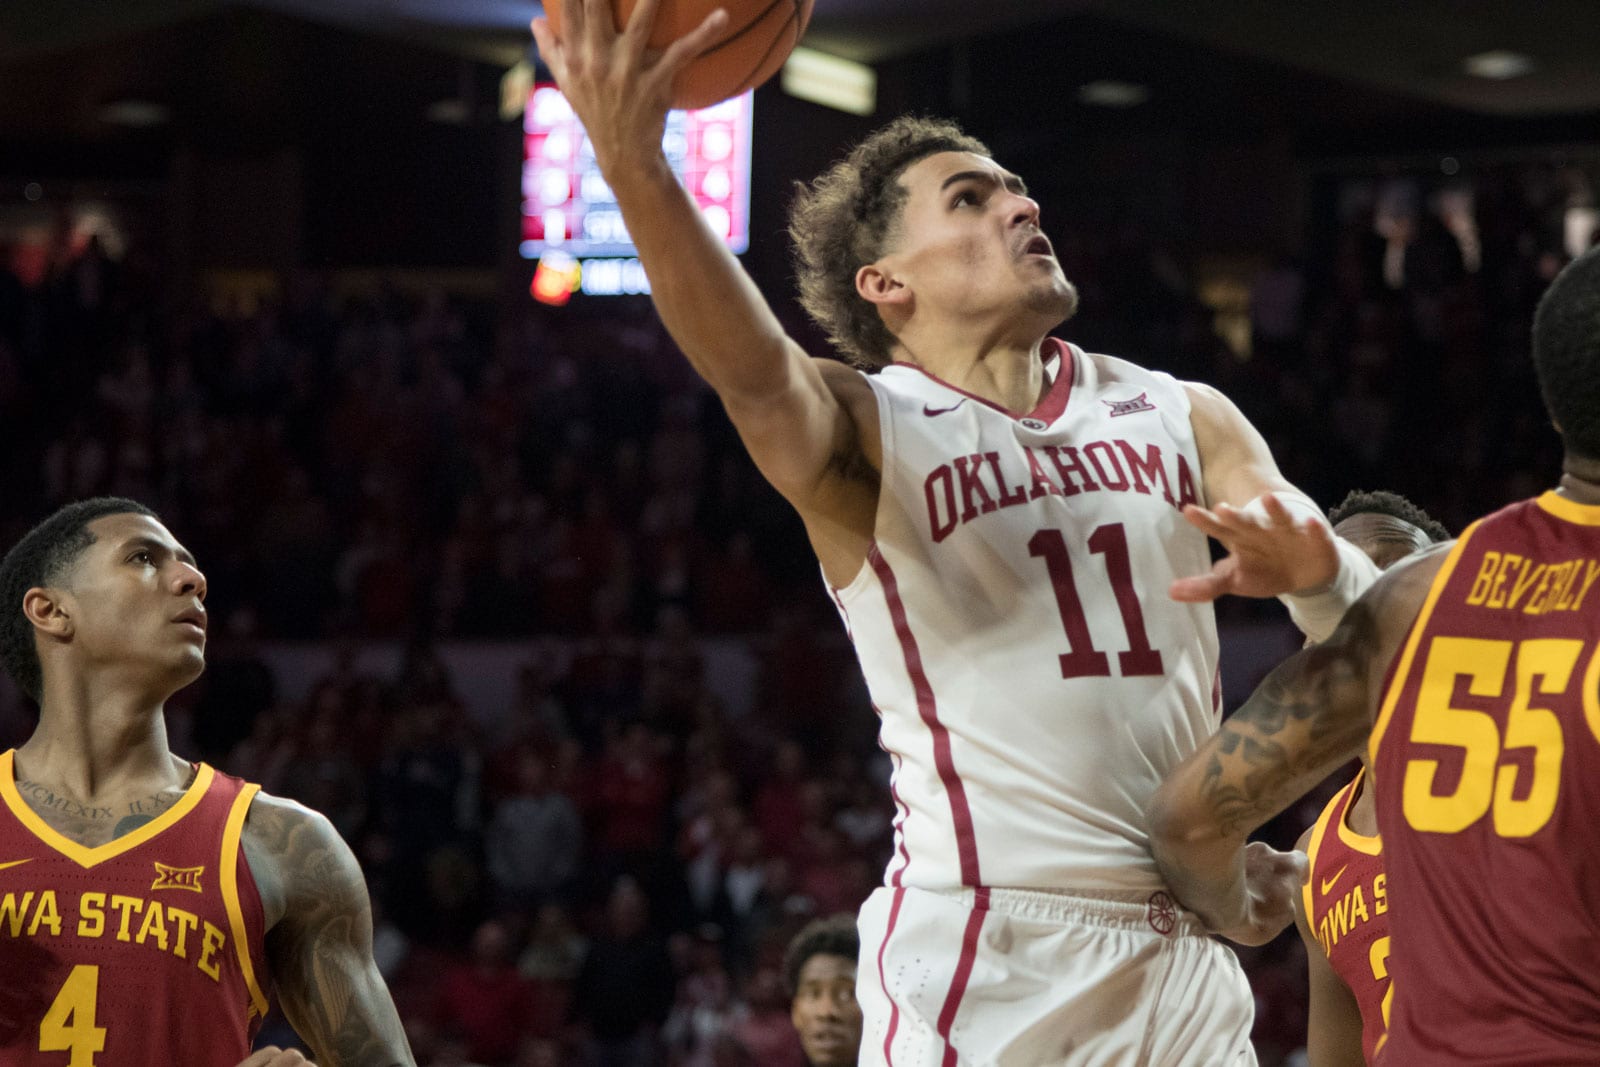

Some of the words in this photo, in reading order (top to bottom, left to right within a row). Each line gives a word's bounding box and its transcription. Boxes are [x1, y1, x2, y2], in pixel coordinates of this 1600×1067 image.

[924, 439, 1197, 543] OKLAHOMA
[1027, 522, 1164, 679] 11
[1403, 636, 1584, 837] 55
[77, 892, 225, 982] STATE
[39, 965, 107, 1067] 4
